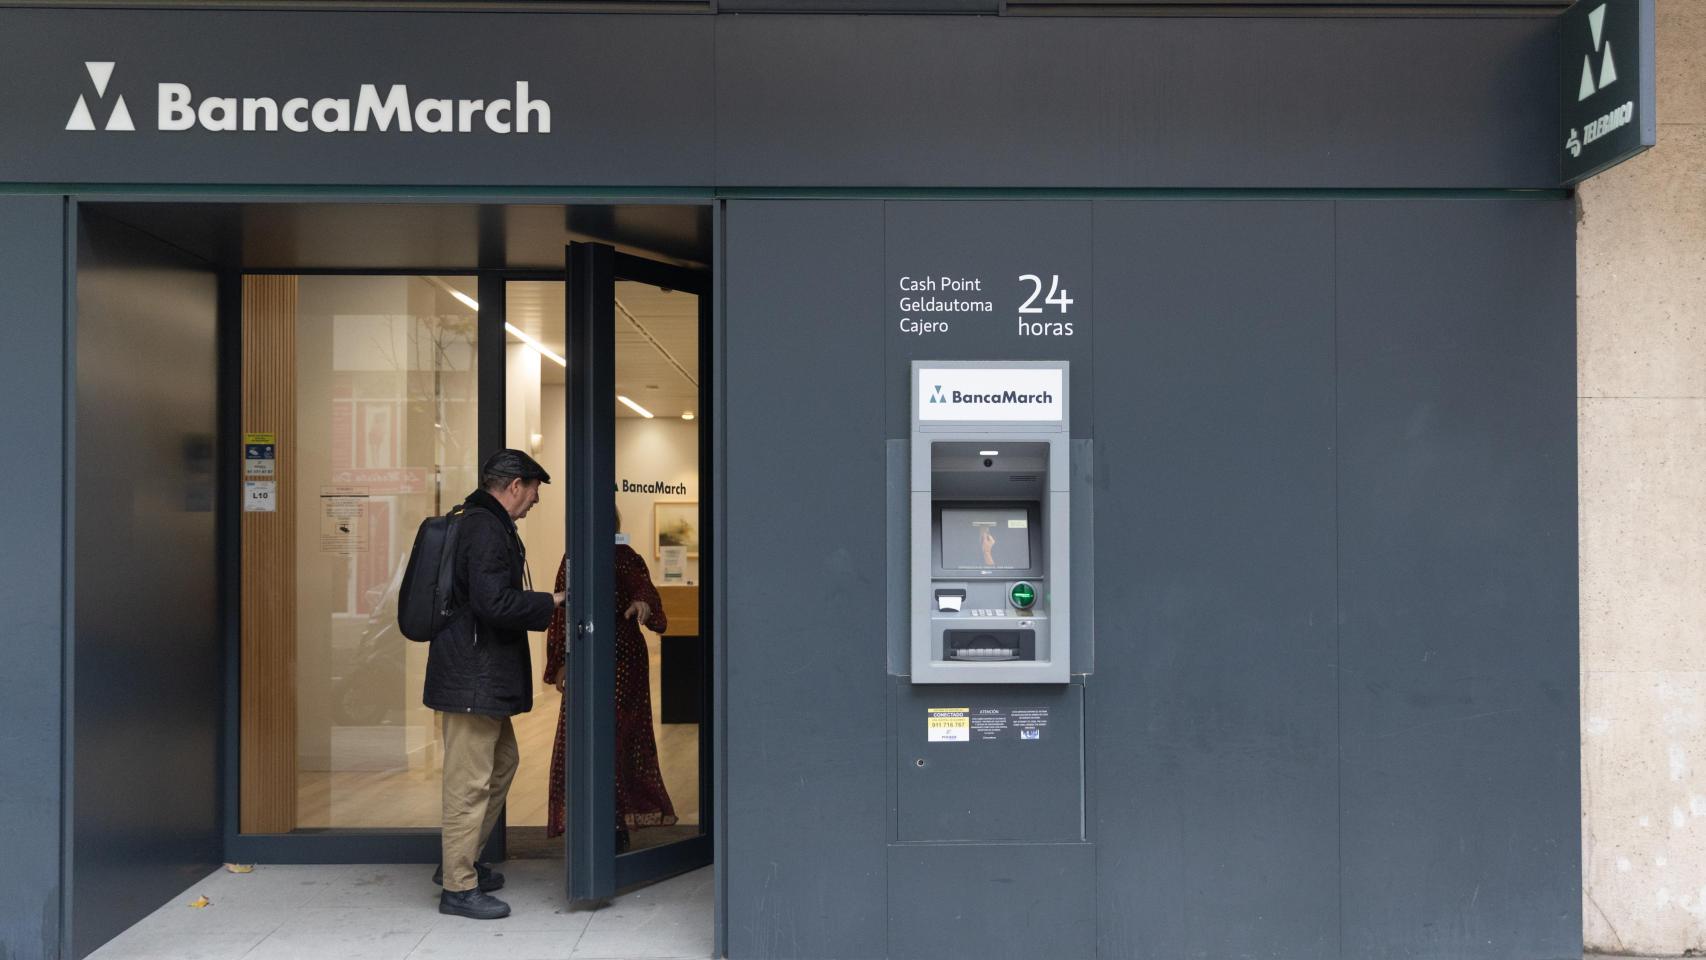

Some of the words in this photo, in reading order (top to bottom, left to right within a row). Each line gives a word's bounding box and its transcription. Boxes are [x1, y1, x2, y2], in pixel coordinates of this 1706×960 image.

[157, 81, 552, 134] BancaMarch
[1583, 101, 1634, 146] TELEBANCO
[899, 276, 936, 291] Cash
[941, 276, 982, 291] Point
[1018, 274, 1074, 314] 24
[899, 297, 993, 312] Geldautoma
[899, 318, 949, 335] Cajero
[1018, 316, 1074, 336] horas
[952, 390, 1053, 404] BancaMarch
[622, 479, 687, 495] BancaMarch
